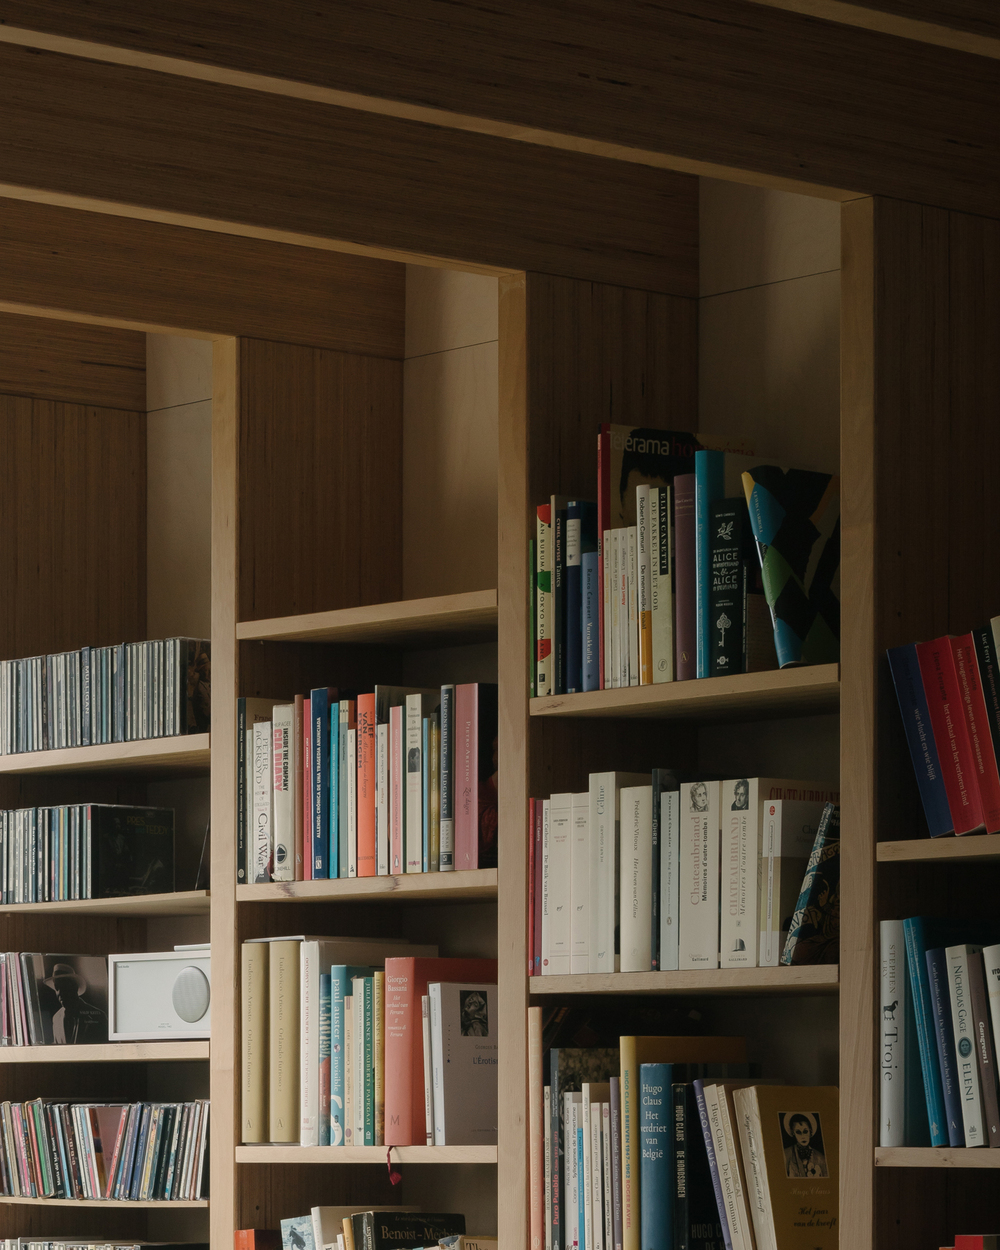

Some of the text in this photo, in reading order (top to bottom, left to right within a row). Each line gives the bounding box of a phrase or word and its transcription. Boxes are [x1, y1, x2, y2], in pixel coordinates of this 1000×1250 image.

[606, 430, 670, 456] Télérama
[713, 552, 738, 562] ALICE
[713, 575, 737, 585] ALICE
[274, 728, 283, 792] CIA DIARY
[945, 714, 956, 738] verhaal
[955, 762, 964, 789] verloren
[961, 788, 969, 807] kind
[145, 825, 169, 835] TEDDY
[690, 816, 700, 906] Chateaubriand
[730, 816, 739, 916] CHATEAUBRIAND
[888, 944, 896, 994] STEPHEN
[332, 979, 344, 1040] paul auster
[953, 964, 967, 1034] NICHOLAS GAGE
[881, 1026, 899, 1081] Troje
[642, 1084, 663, 1095] Hugo
[962, 1062, 975, 1101] ELENI
[642, 1096, 662, 1106] Claus
[645, 1111, 659, 1120] Het
[640, 1124, 666, 1134] verdriet
[645, 1137, 658, 1145] van
[642, 1149, 664, 1161] België
[676, 1105, 685, 1198] HUGO CLAUS DE HONDSDAGEN
[711, 1103, 739, 1234] Hugo Claus De koele minnaar
[794, 1217, 836, 1230] van de kreeft
[812, 1208, 829, 1220] jaar
